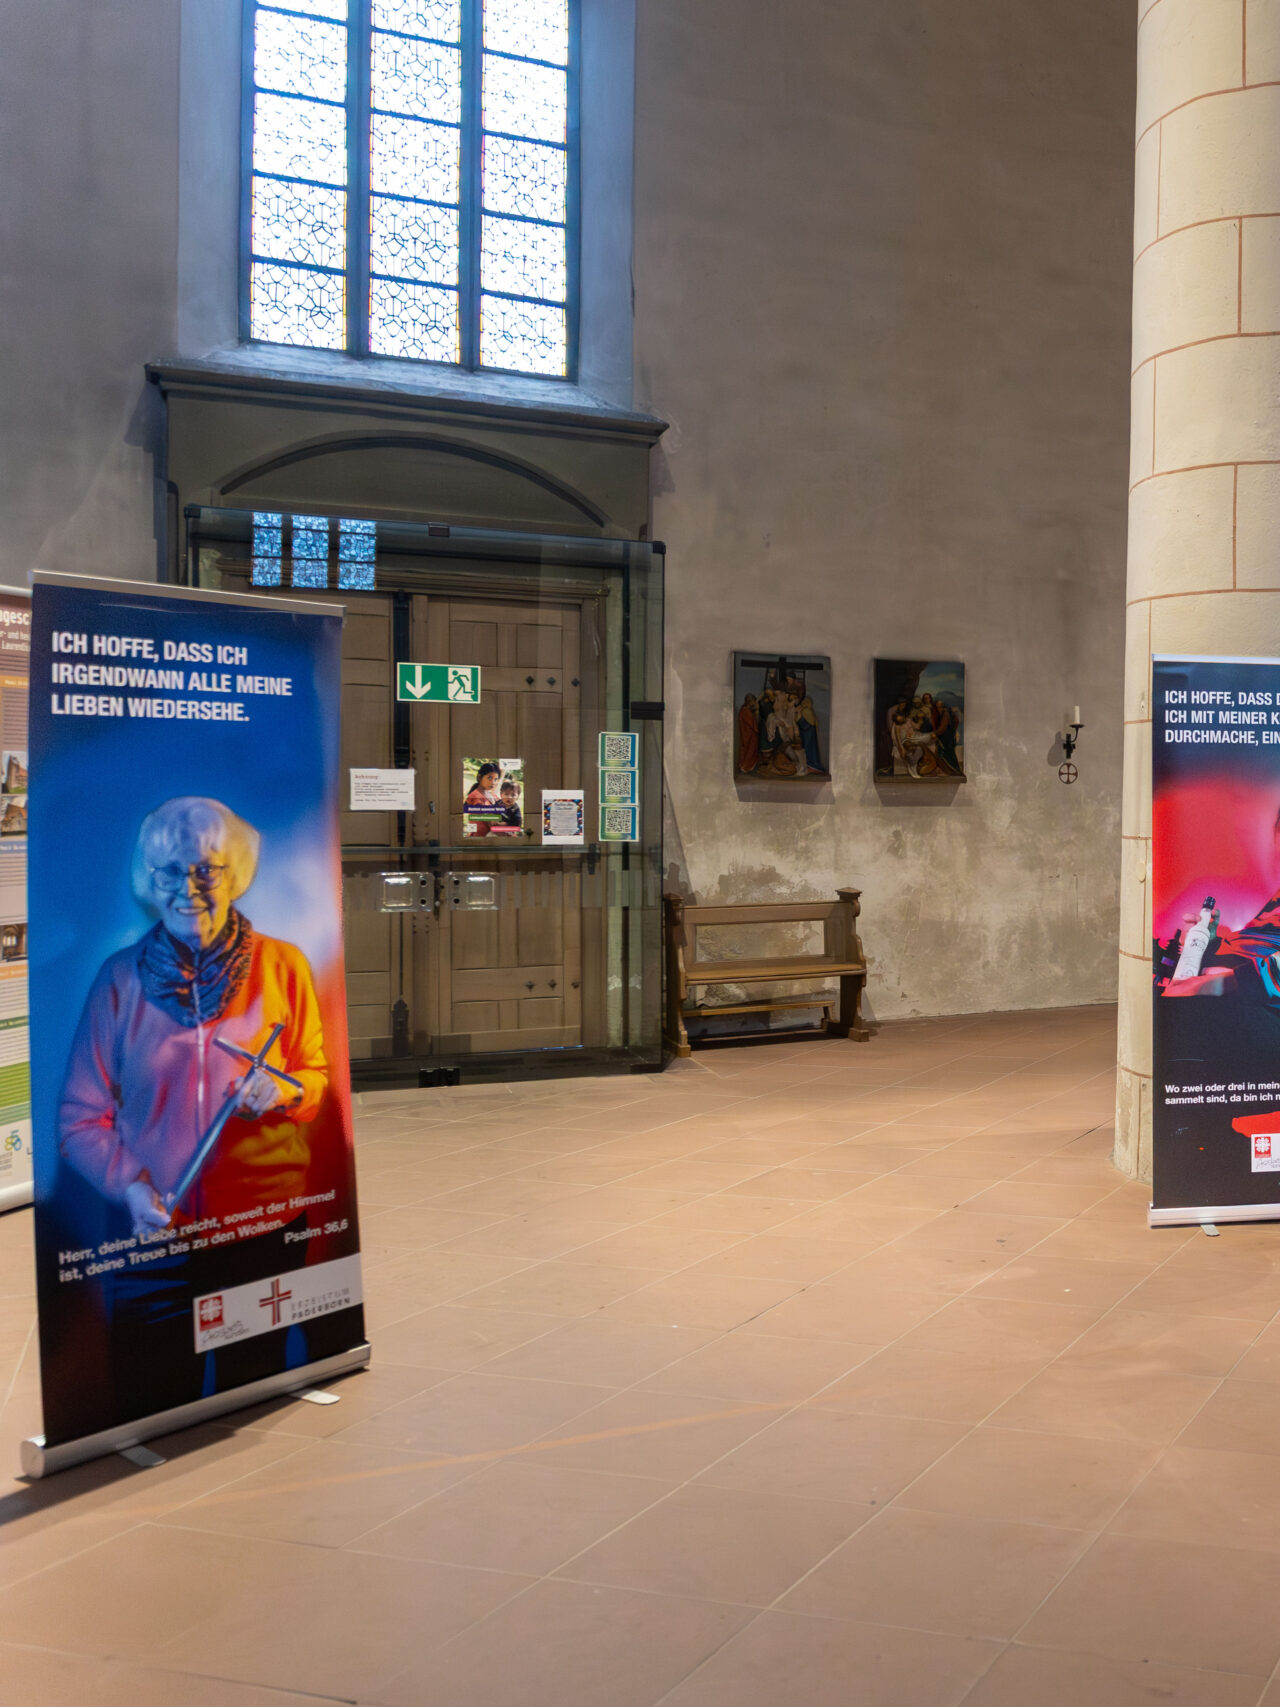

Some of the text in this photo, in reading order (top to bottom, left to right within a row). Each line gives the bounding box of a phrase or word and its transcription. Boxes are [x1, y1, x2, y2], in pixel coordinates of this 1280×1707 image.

[52, 631, 87, 655] ICH
[93, 634, 159, 663] HOFFE,
[164, 640, 213, 664] DASS
[217, 645, 248, 666] ICH
[52, 662, 184, 690] IRGENDWANN
[188, 672, 232, 693] ALLE
[236, 675, 293, 696] MEINE
[52, 694, 250, 722] LIEBEN WIEDERSEHE.
[1165, 690, 1187, 704] ICH
[1191, 691, 1235, 707] HOFFE,
[1238, 692, 1272, 706] DASS
[1165, 710, 1187, 724] ICH
[1191, 710, 1215, 724] MIT
[1218, 711, 1268, 725] MEINER
[1165, 730, 1259, 746] DURCHMACHE,
[1165, 1084, 1180, 1094] Wo
[1182, 1084, 1203, 1093] zwei
[1204, 1083, 1226, 1092] oder
[1228, 1082, 1246, 1091] drei
[1248, 1082, 1256, 1091] in
[1165, 1096, 1204, 1105] sammelt
[1206, 1094, 1228, 1104] sind,
[1230, 1093, 1242, 1102] da
[1244, 1093, 1258, 1102] bin
[1260, 1092, 1274, 1101] ich
[58, 1189, 336, 1265] Herr, deine Liebe reicht, soweit der Himmel
[284, 1219, 349, 1244] Psalm 36,6
[59, 1219, 286, 1283] ist, deine Treue bis zu den Wolken.
[292, 1296, 350, 1320] PADERBORN
